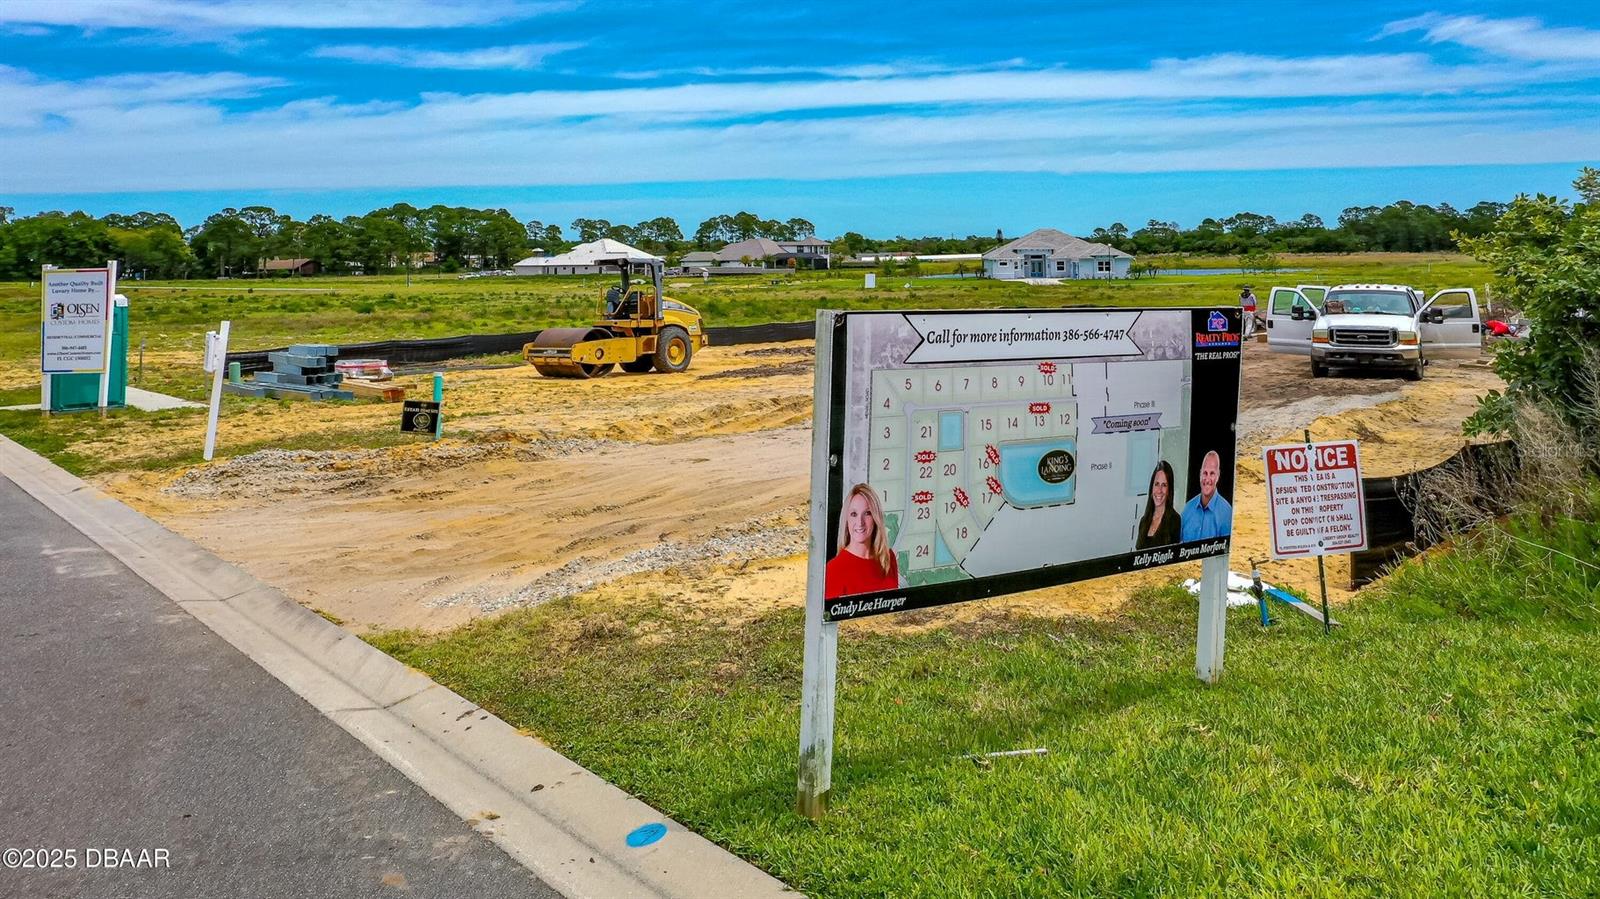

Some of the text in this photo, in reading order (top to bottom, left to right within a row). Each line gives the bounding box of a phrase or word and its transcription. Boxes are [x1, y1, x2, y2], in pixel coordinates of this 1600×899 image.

[927, 328, 1125, 347] Call for more information 386-566-4747
[1039, 364, 1055, 372] SOLD
[905, 379, 912, 390] 5
[964, 379, 969, 390] 7
[992, 378, 998, 388] 8
[1018, 376, 1024, 387] 9
[1043, 375, 1054, 386] 10
[1062, 374, 1071, 384] 11
[935, 380, 941, 391] 6
[883, 398, 890, 409] 4
[981, 419, 992, 430] 15
[1007, 417, 1018, 429] 14
[1034, 415, 1045, 427] 13
[1060, 414, 1070, 425] 12
[1104, 419, 1132, 429] "Coming
[884, 426, 890, 438] 3
[920, 426, 932, 438] 21
[917, 453, 935, 461] SOLD
[987, 448, 999, 464] SOLD
[883, 458, 890, 470] 2
[943, 464, 956, 476] 20
[978, 458, 990, 470] 16
[1041, 463, 1072, 475] LANDING
[1091, 462, 1108, 470] Phase
[920, 466, 932, 479] 22
[988, 479, 1001, 493] SOLD
[915, 493, 932, 502] SOLD
[955, 489, 968, 506] SOLD
[982, 492, 992, 504] 17
[1321, 492, 1356, 501] TRESPASSING
[917, 507, 930, 520] 23
[945, 502, 956, 514] 19
[1316, 504, 1344, 512] ROPERTY
[956, 527, 967, 539] 18
[916, 545, 929, 557] 24
[1180, 540, 1226, 558] Bryan Morford
[1133, 549, 1174, 567] Kelly Riggle
[830, 597, 906, 616] Cindy Lee Harper
